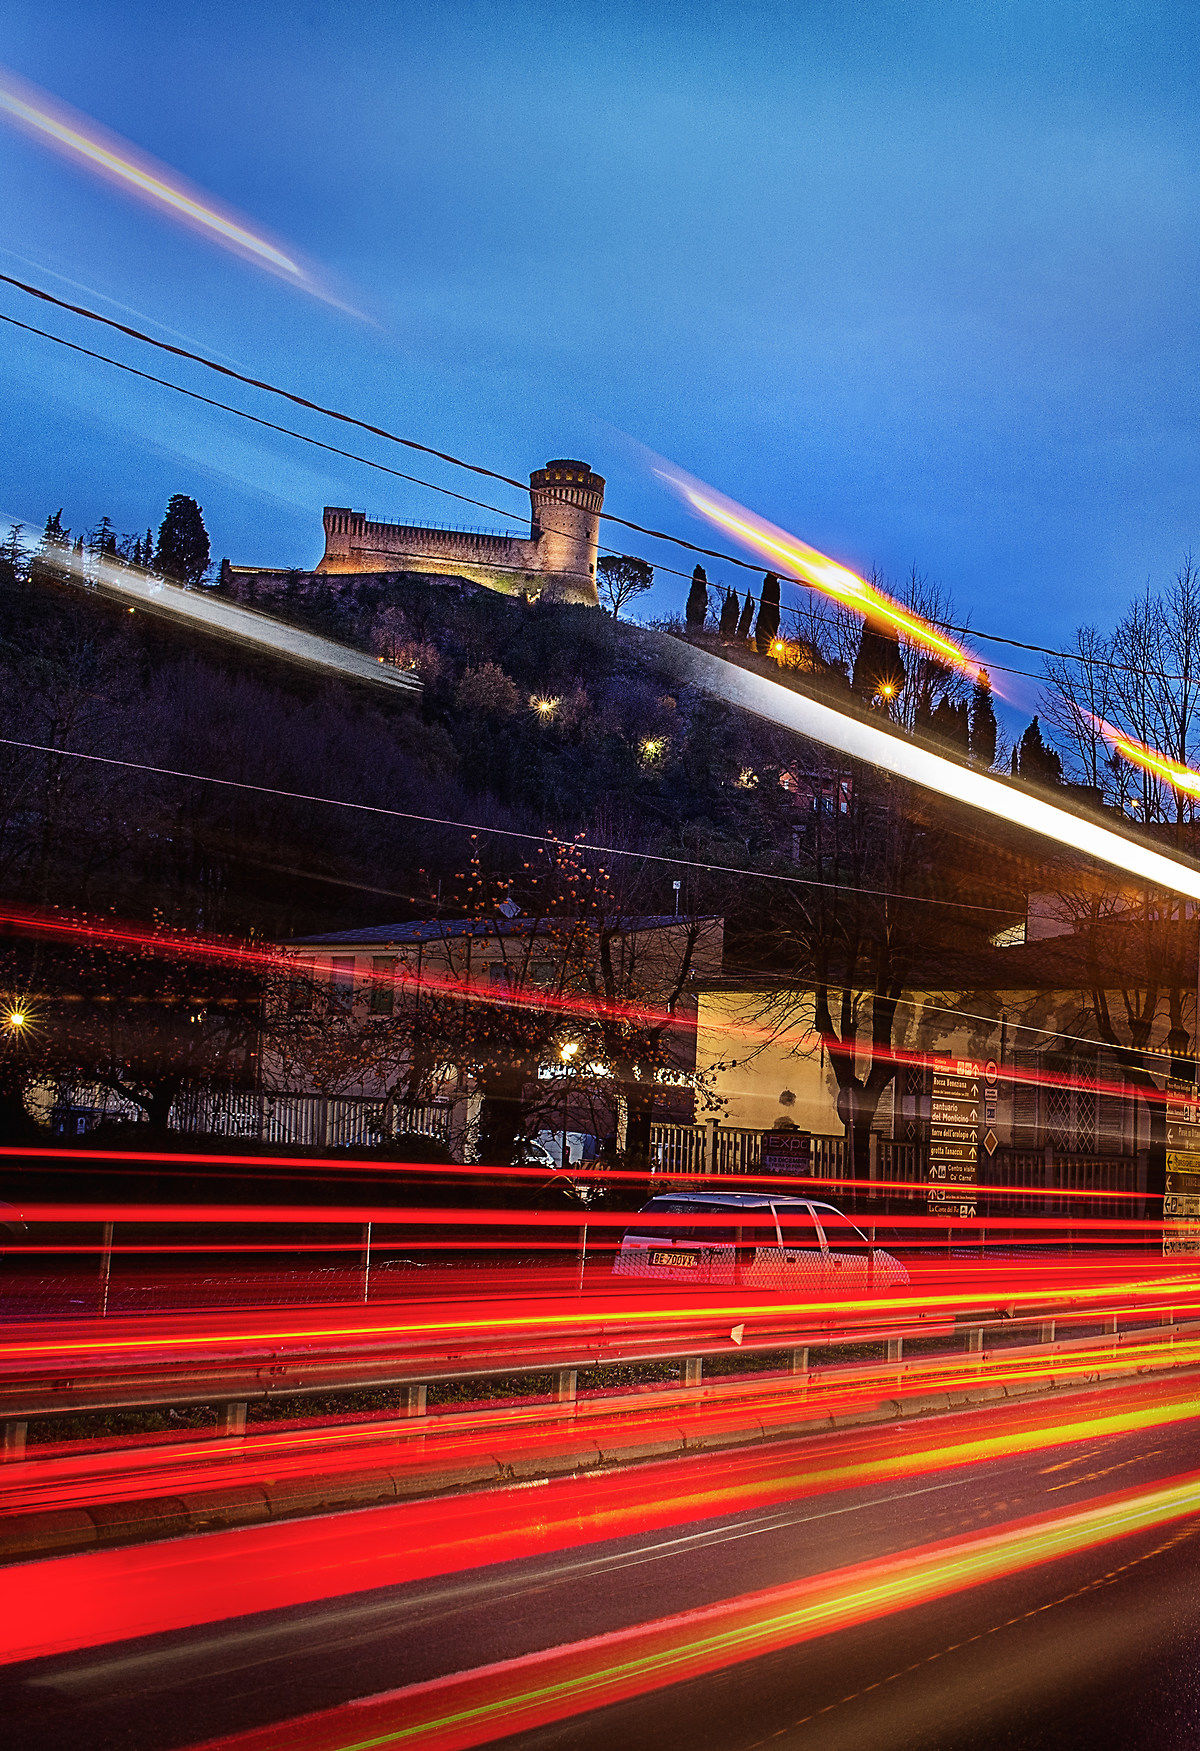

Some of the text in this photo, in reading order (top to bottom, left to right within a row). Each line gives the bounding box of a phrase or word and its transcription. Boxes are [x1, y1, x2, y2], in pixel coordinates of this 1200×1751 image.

[933, 1103, 958, 1111] santuario
[932, 1112, 969, 1123] del Monticino
[931, 1129, 969, 1140] torre dell'orologio
[931, 1147, 963, 1156] grotta Tanaccia
[655, 1253, 665, 1264] BE
